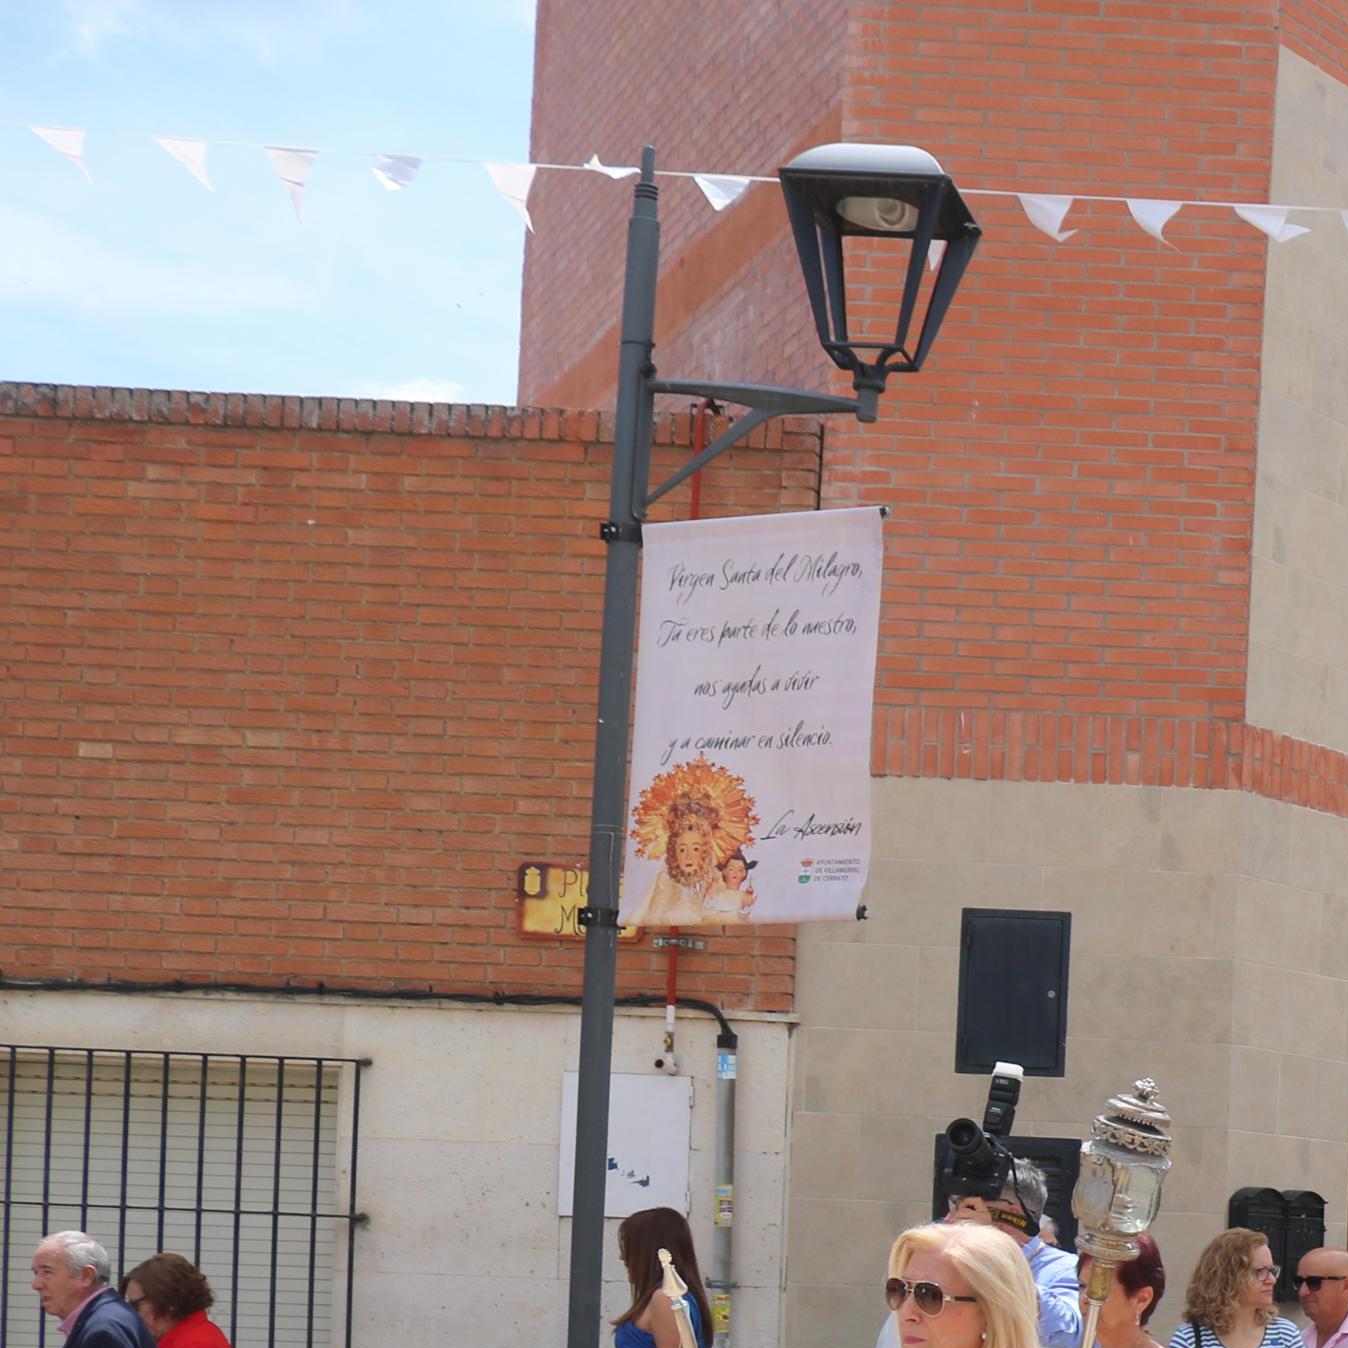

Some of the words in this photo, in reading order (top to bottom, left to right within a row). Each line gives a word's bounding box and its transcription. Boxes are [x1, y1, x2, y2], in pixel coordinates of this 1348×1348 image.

[669, 562, 715, 606] Virgen
[720, 558, 760, 590] Santa
[765, 552, 799, 585] del
[794, 551, 863, 597] Milagro,
[686, 625, 715, 643] eres
[717, 618, 760, 648] parte
[761, 608, 782, 640] de
[784, 609, 800, 638] lo
[801, 612, 857, 636] nuestro,
[694, 679, 717, 697] nos
[721, 665, 766, 710] ayudas
[770, 681, 780, 692] a
[784, 670, 820, 692] vivir
[660, 738, 679, 766] y
[680, 738, 691, 750] a
[694, 730, 755, 750] caminar
[758, 736, 774, 749] en
[777, 720, 832, 750] silencio.
[760, 809, 794, 840] La
[793, 813, 862, 840] Ascensión
